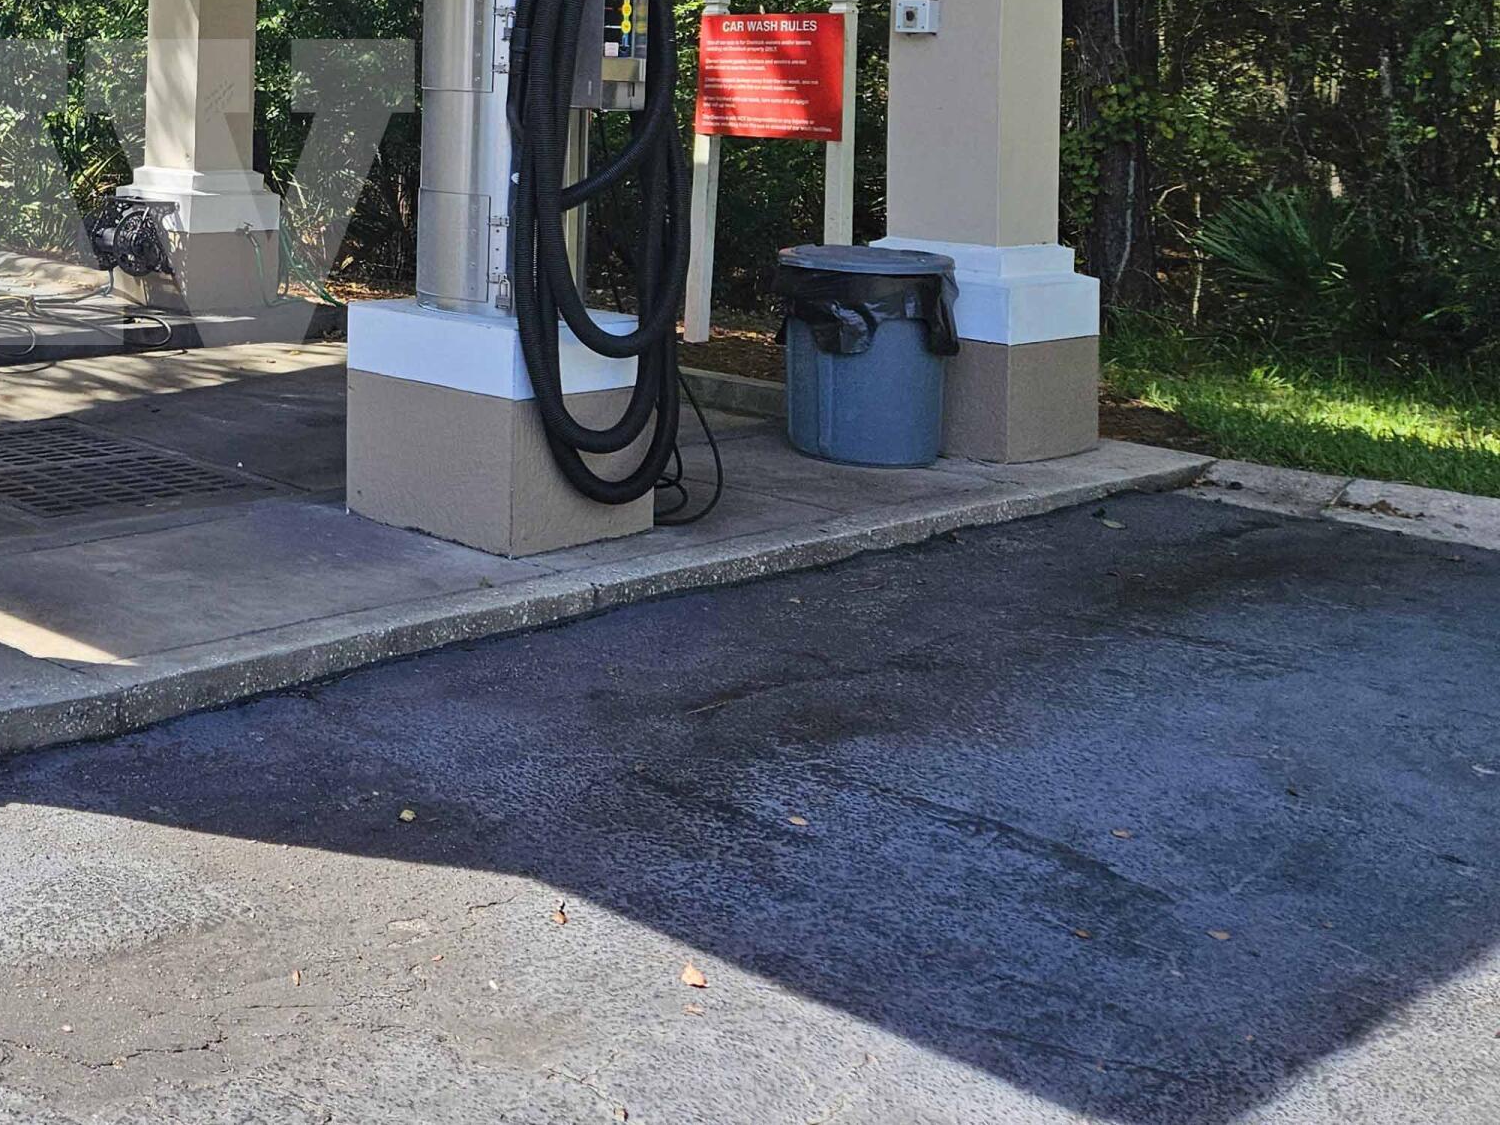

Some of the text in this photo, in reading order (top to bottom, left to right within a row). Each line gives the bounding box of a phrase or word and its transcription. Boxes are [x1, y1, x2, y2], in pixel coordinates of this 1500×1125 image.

[722, 20, 817, 32] CAR WASH RULES
